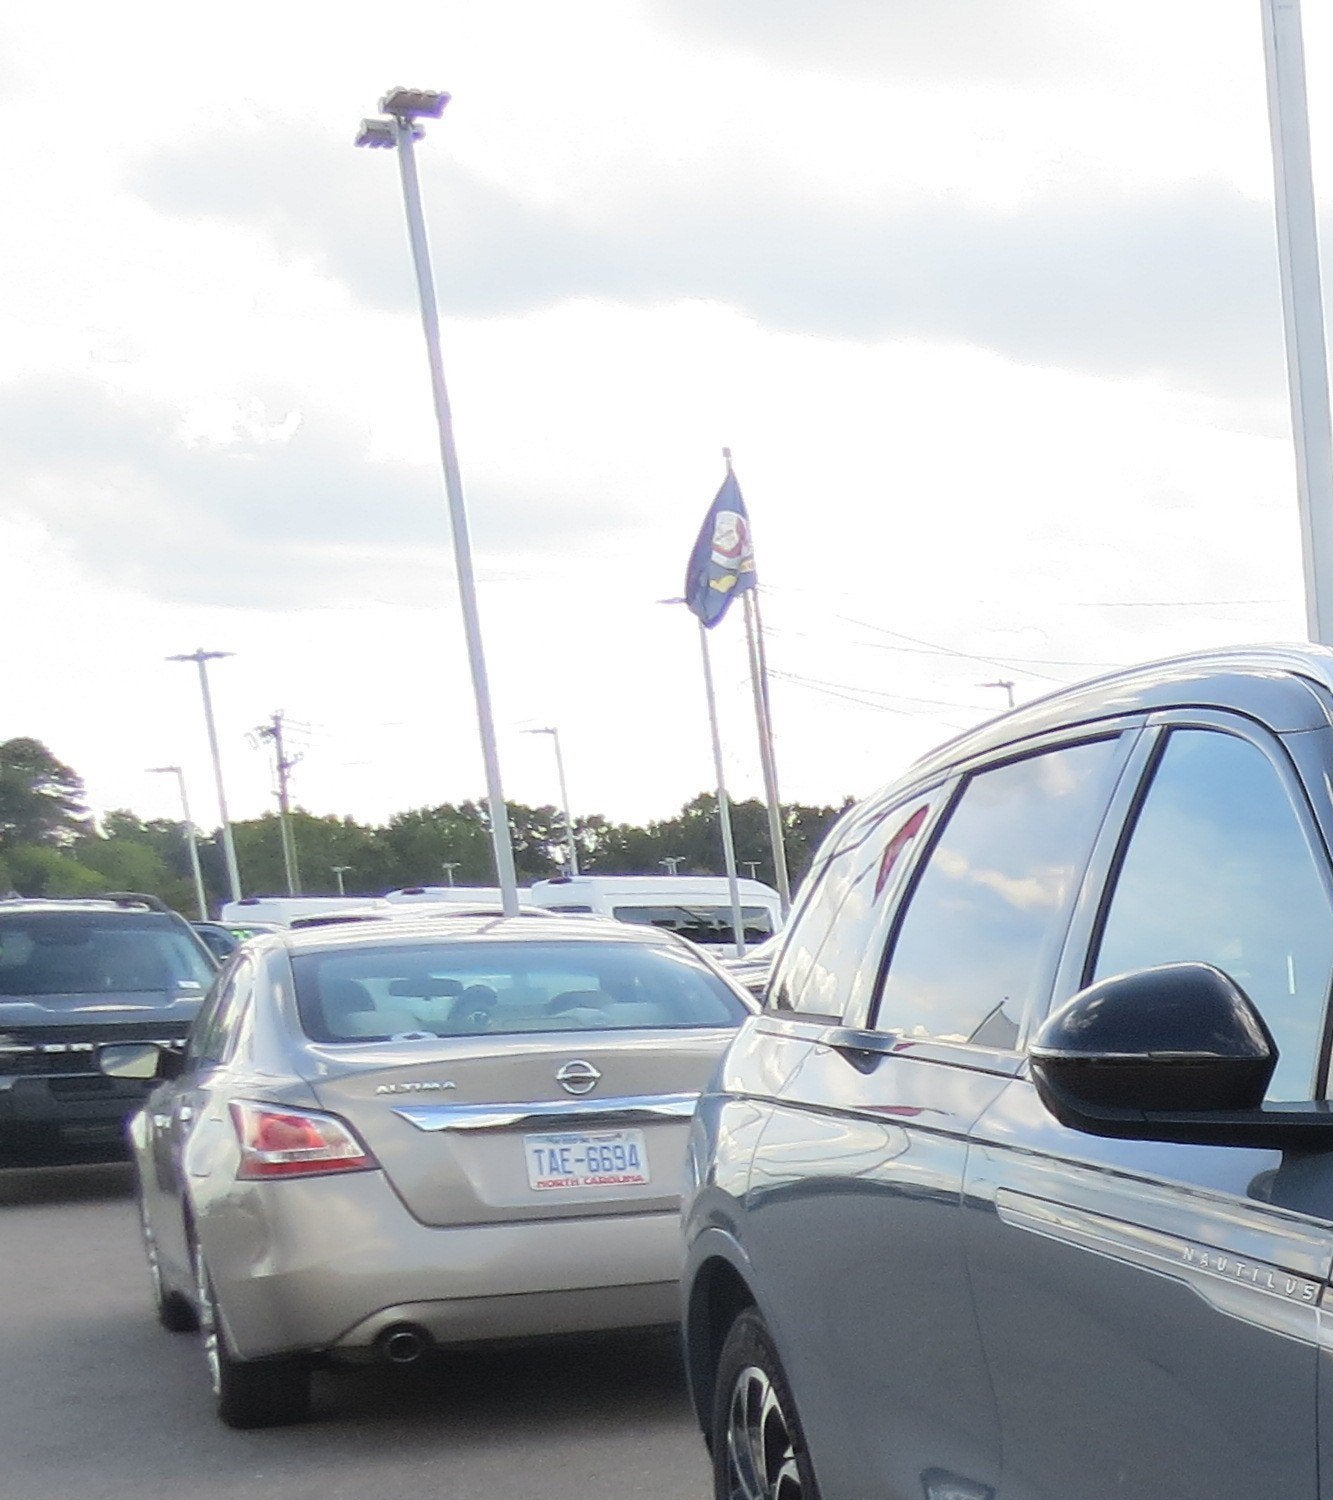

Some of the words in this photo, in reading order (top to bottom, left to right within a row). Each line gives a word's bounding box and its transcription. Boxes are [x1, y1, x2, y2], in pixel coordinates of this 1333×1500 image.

[375, 1081, 456, 1095] ALTIMA
[533, 1143, 641, 1176] TAE-6694
[1181, 1246, 1315, 1302] NAUTILUS
